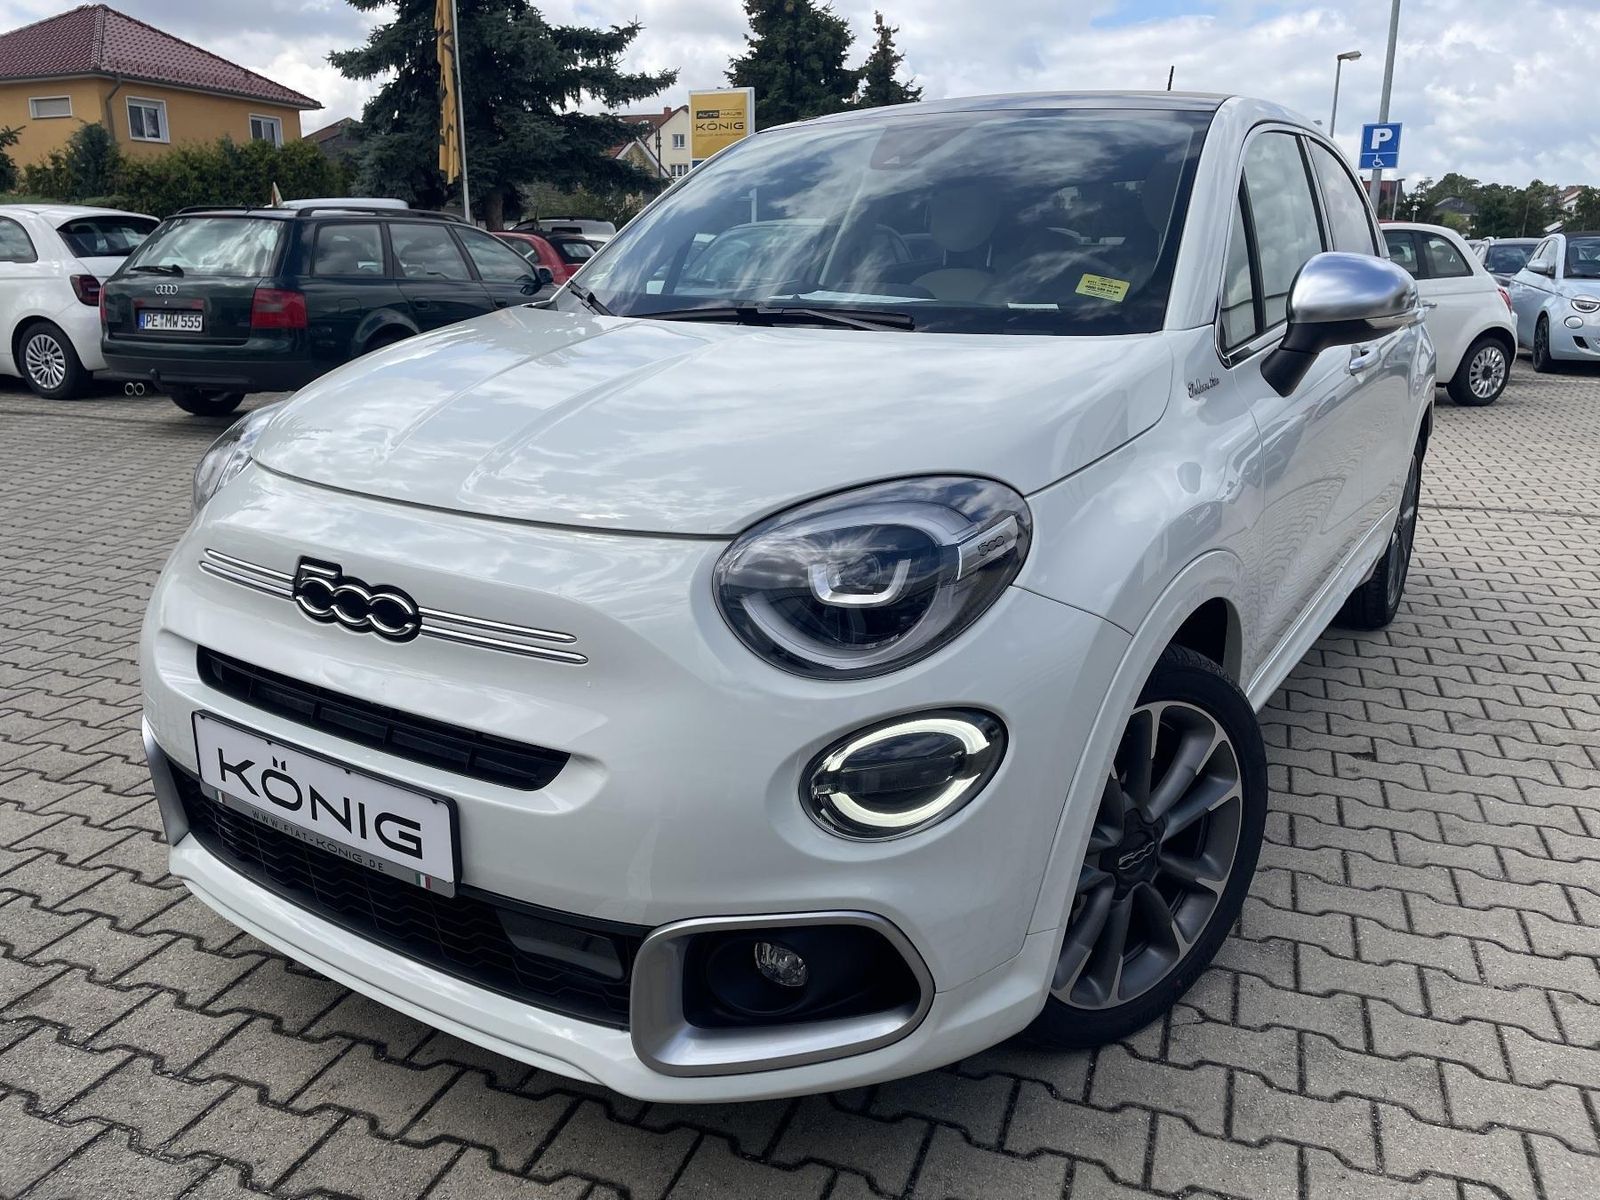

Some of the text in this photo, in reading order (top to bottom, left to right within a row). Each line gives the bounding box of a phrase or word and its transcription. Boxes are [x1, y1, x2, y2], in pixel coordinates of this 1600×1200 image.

[696, 120, 744, 131] KÖNIG
[1371, 128, 1393, 149] P
[145, 314, 201, 329] PE MW 555
[977, 535, 1005, 557] 500
[294, 557, 419, 641] 500
[217, 747, 423, 860] KÖNIG
